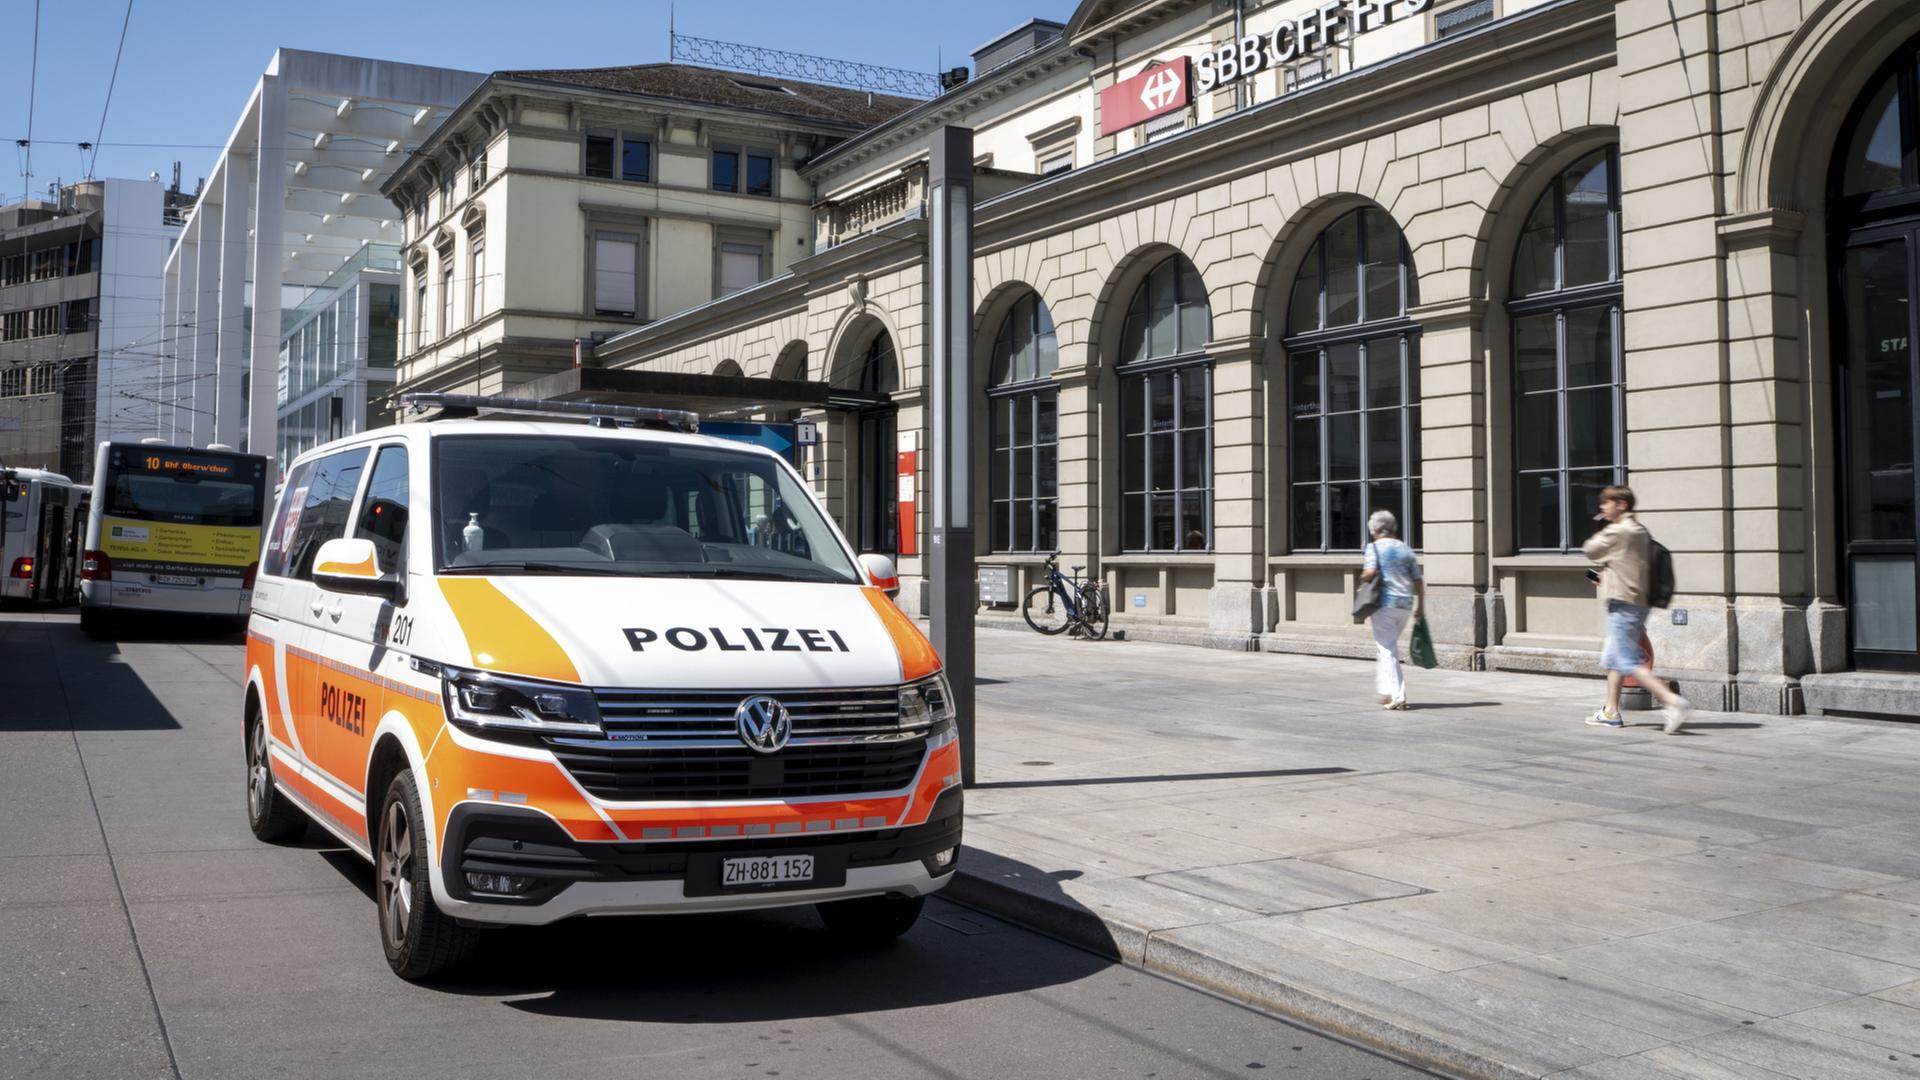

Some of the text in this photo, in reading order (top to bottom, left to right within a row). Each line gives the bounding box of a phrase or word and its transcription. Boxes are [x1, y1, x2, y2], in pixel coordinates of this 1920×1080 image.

[1197, 0, 1430, 92] SBB CFF FF
[145, 456, 160, 470] 10
[392, 614, 415, 646] 201
[622, 627, 850, 652] POLIZEI
[321, 681, 366, 736] POLIZEI
